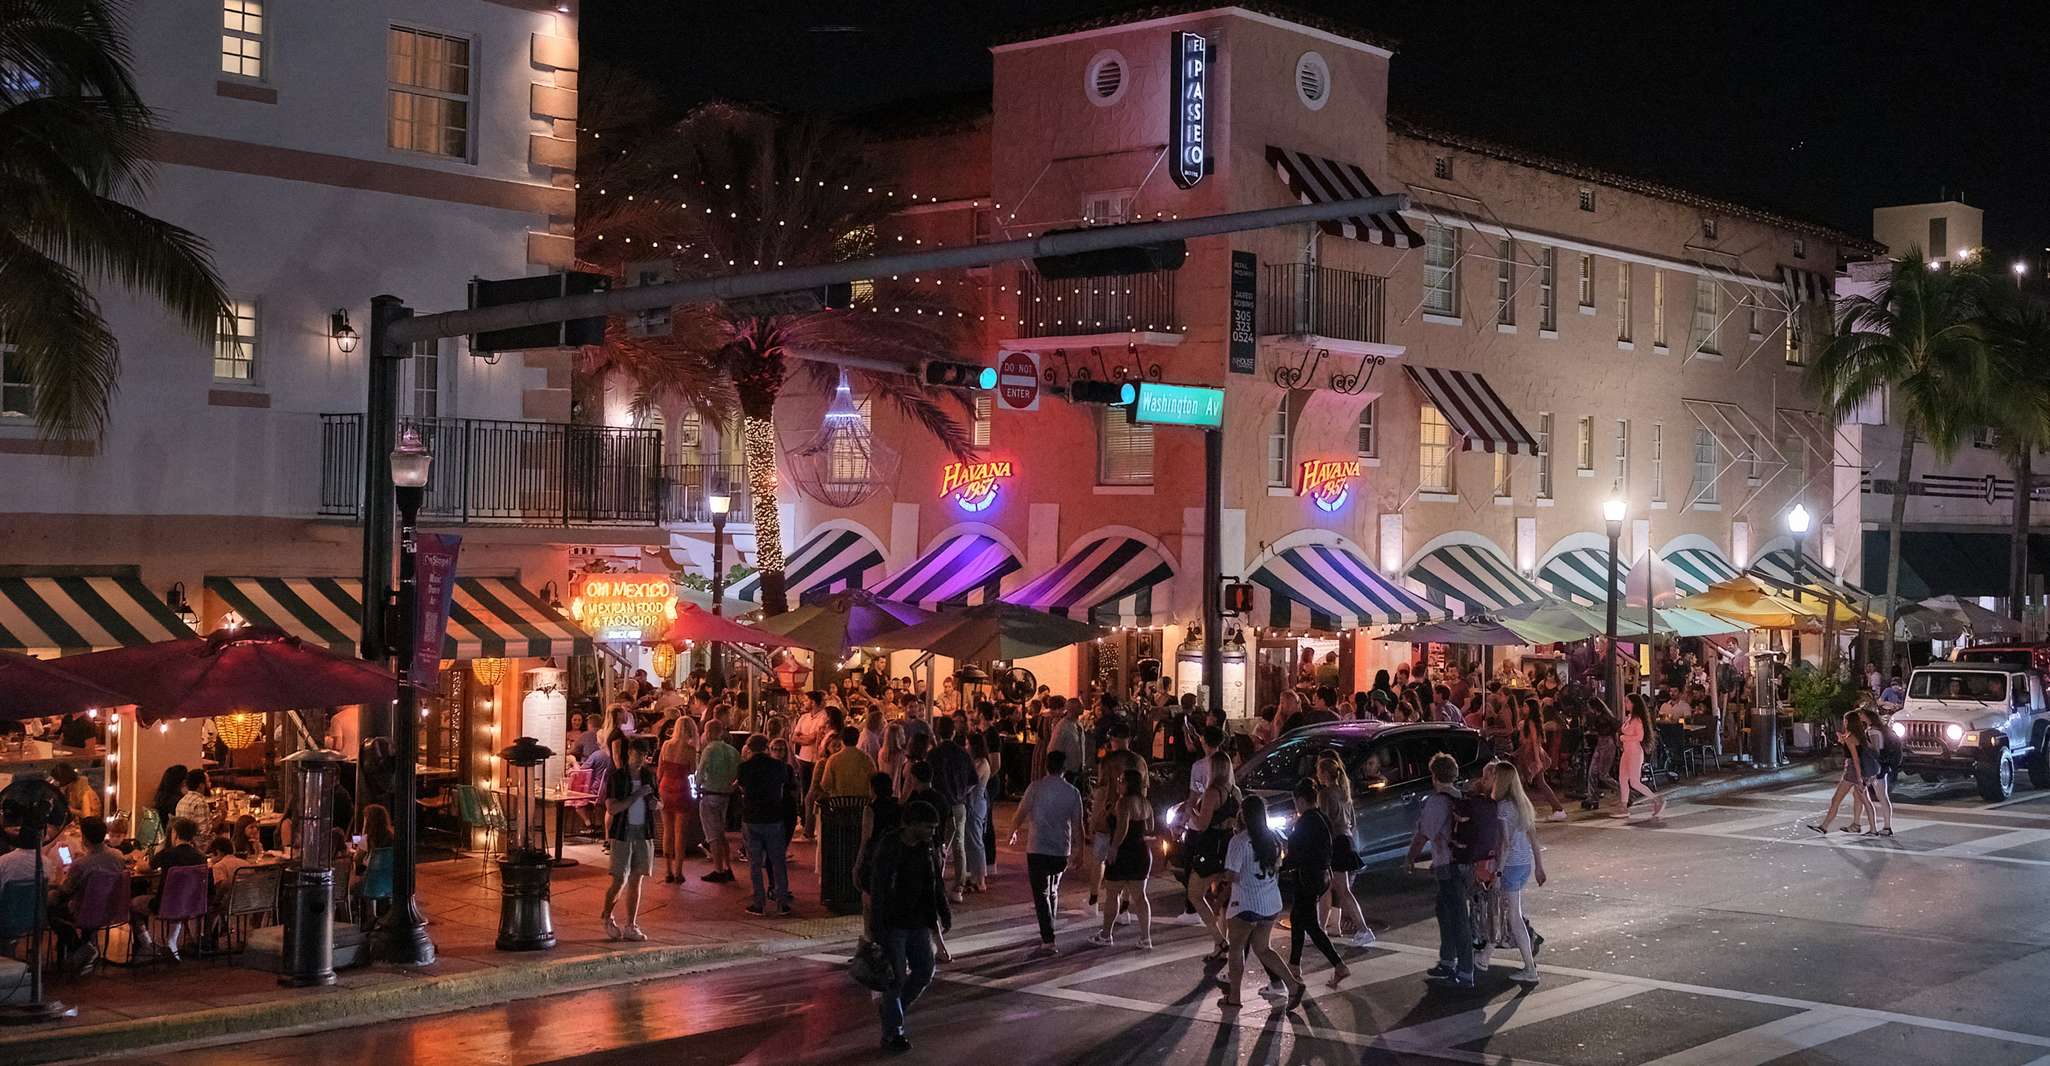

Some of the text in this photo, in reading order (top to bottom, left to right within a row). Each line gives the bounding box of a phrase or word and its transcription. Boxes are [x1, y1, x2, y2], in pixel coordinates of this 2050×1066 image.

[1193, 39, 1205, 52] EL
[1191, 59, 1203, 164] PASEO
[1235, 310, 1251, 321] 305
[1235, 321, 1251, 332] 323
[1232, 331, 1254, 344] 0524
[1004, 362, 1032, 374] DO NOT
[1007, 388, 1030, 399] ENTER
[1143, 391, 1220, 418] Washington Av
[939, 462, 1012, 498] HAVANA
[1300, 460, 1361, 497] HAVANA
[963, 477, 996, 502] 1957
[1321, 477, 1347, 501] 1957
[612, 581, 670, 598] MEXICO
[588, 601, 664, 615] MEXICAN FOOD
[592, 614, 658, 628] & TACO SHOP
